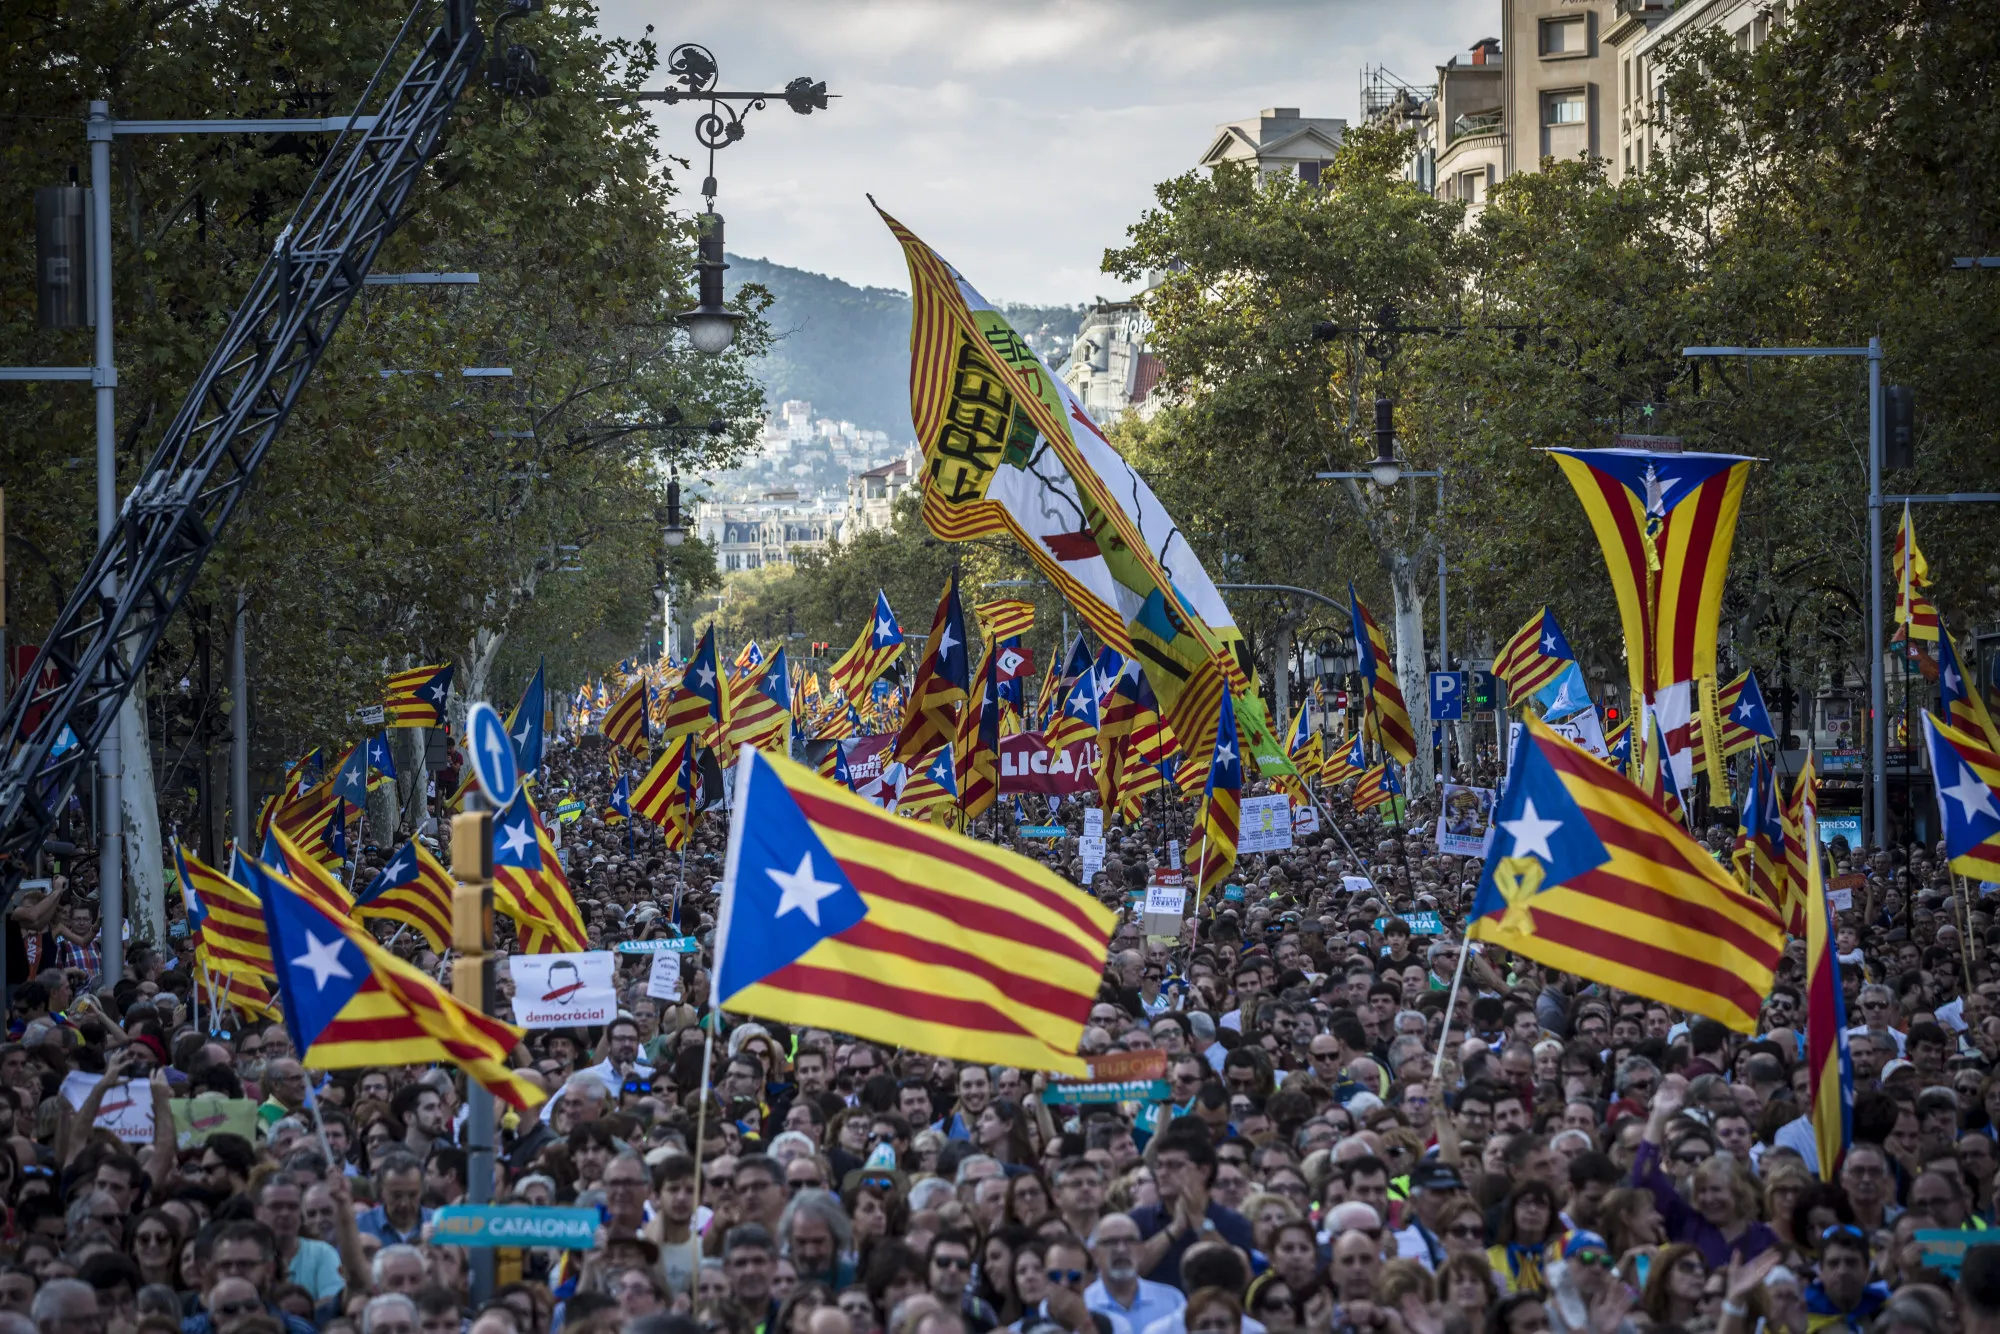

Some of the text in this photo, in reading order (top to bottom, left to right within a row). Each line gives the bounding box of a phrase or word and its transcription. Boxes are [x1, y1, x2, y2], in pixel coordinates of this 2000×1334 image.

[1435, 675, 1456, 701] P
[849, 761, 882, 773] OSTRE
[1001, 749, 1074, 777] LICA
[623, 939, 686, 950] LLIBERTAT
[488, 1216, 593, 1238] CATALONIA
